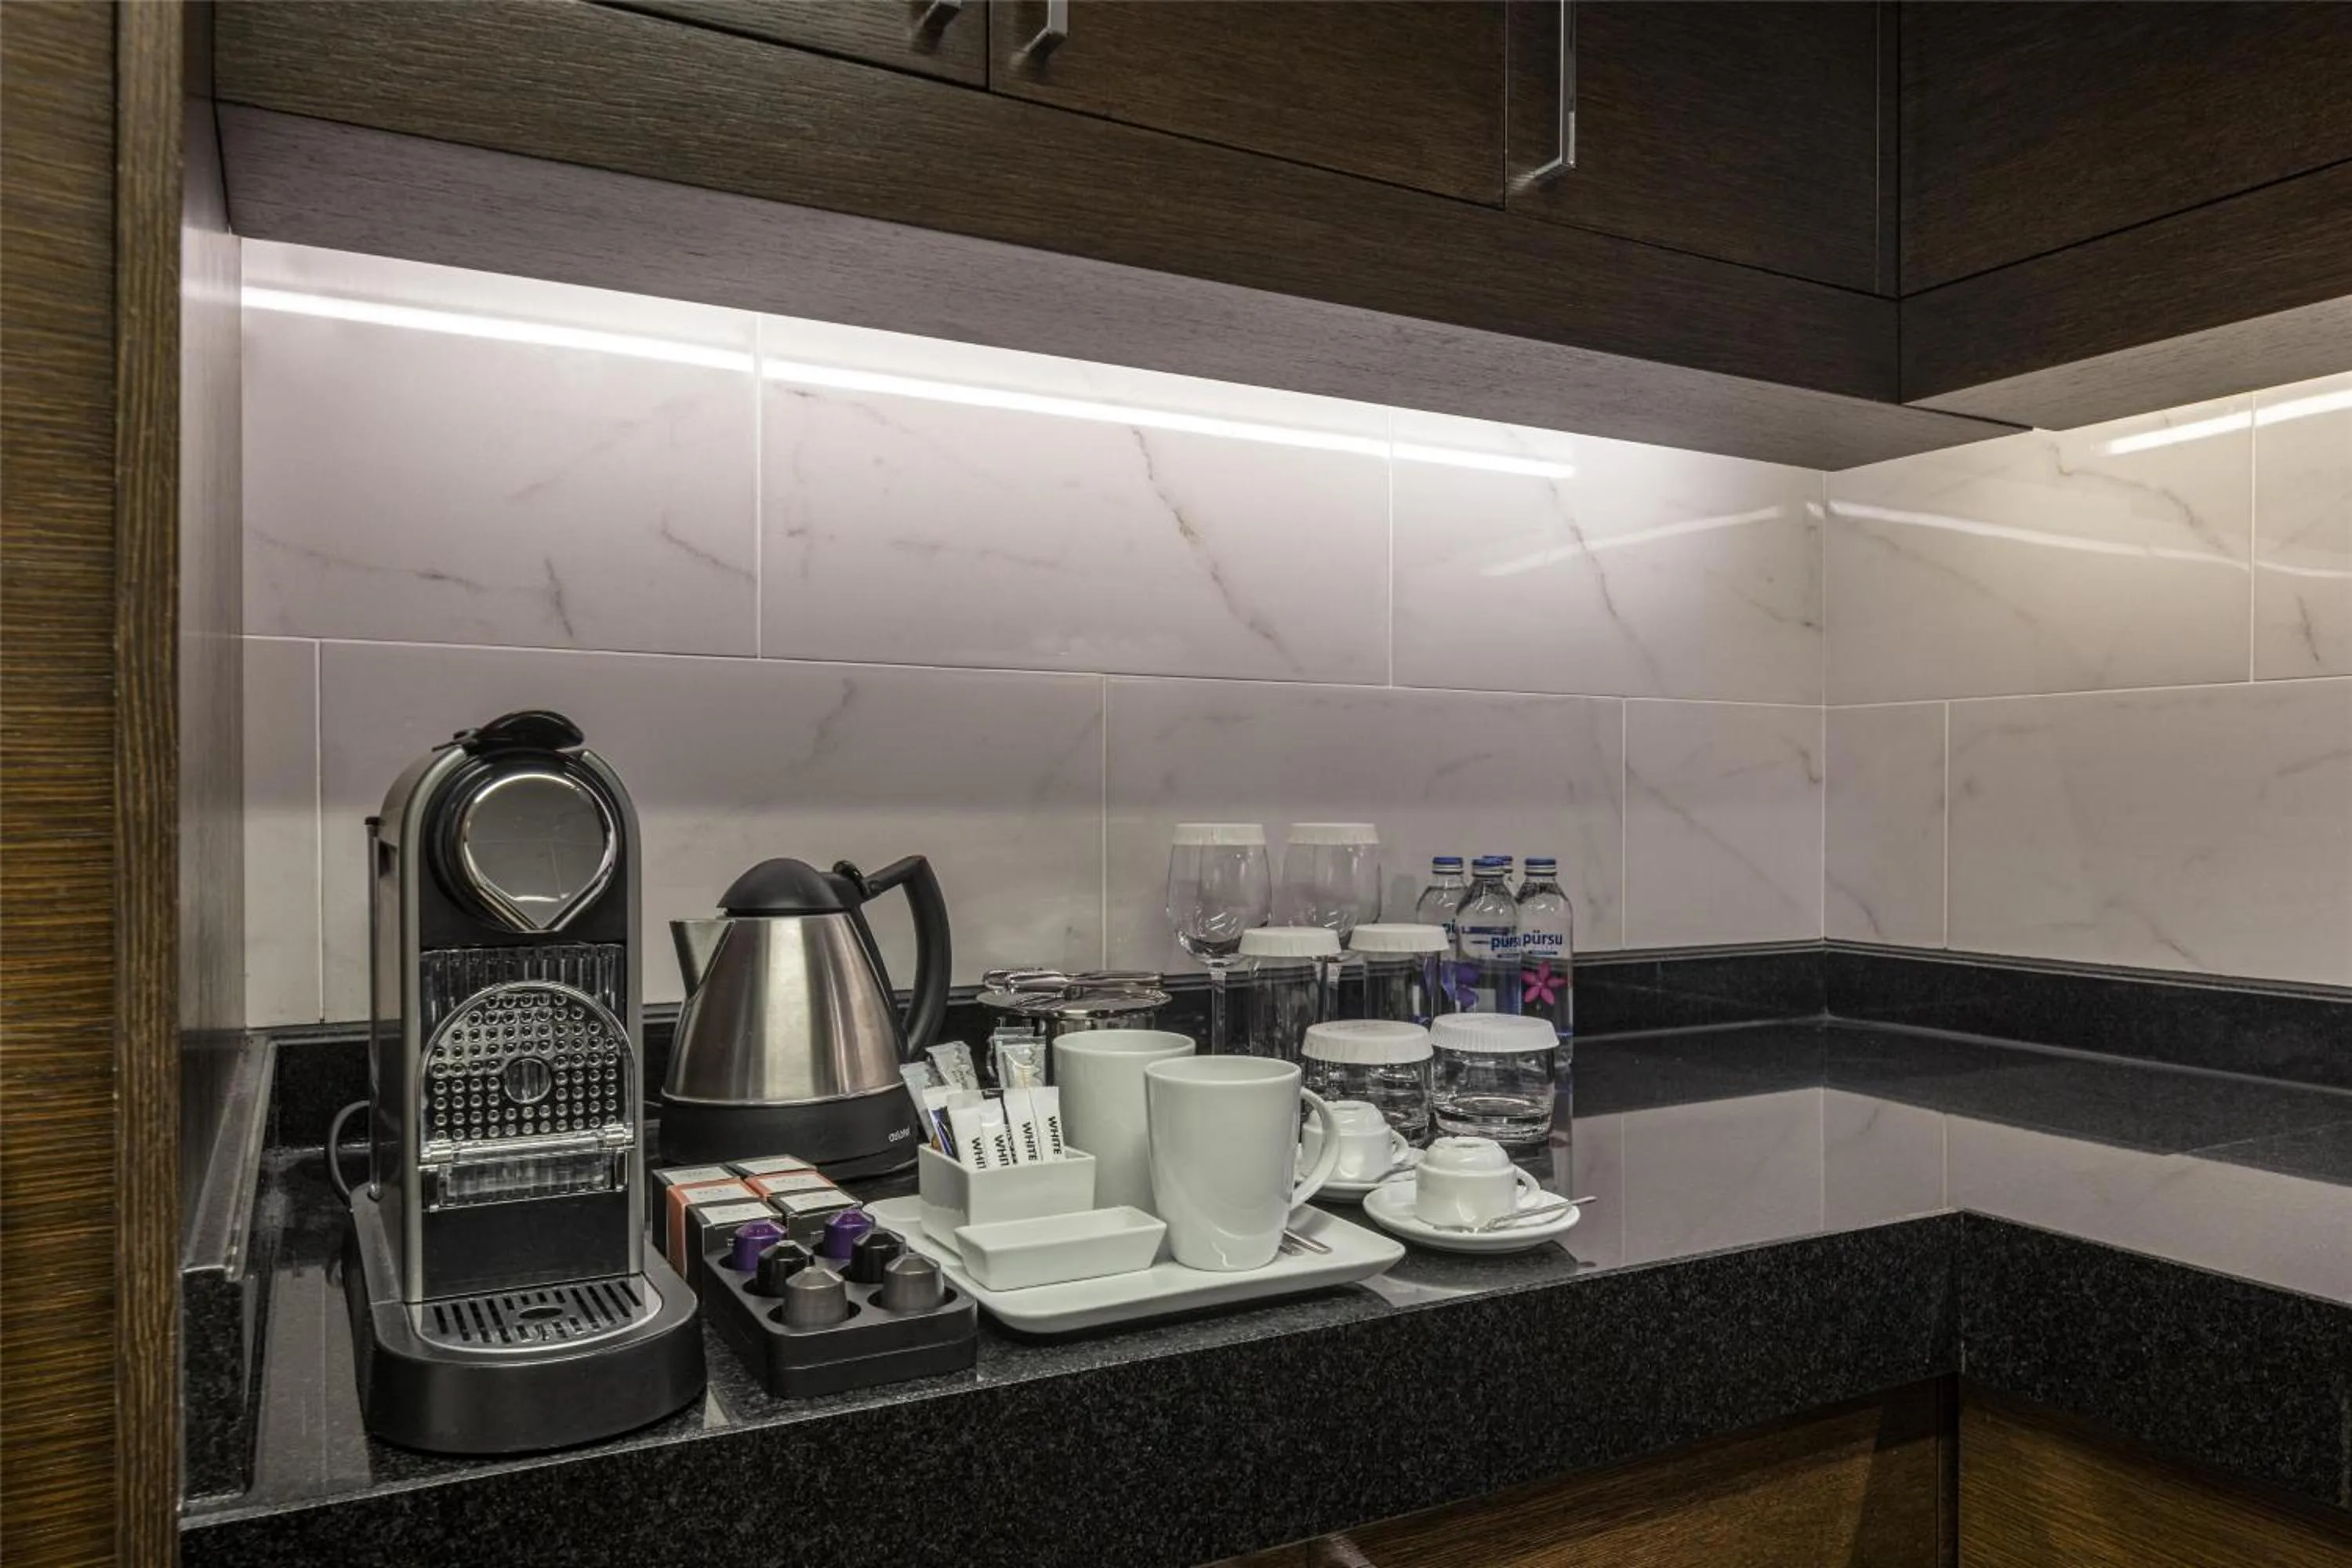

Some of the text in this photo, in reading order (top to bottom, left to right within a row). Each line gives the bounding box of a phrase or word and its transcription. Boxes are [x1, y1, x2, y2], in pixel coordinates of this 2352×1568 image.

[1523, 929, 1563, 947] pürsu
[1022, 1121, 1038, 1160] WHITE
[1047, 1116, 1062, 1155] WHITE
